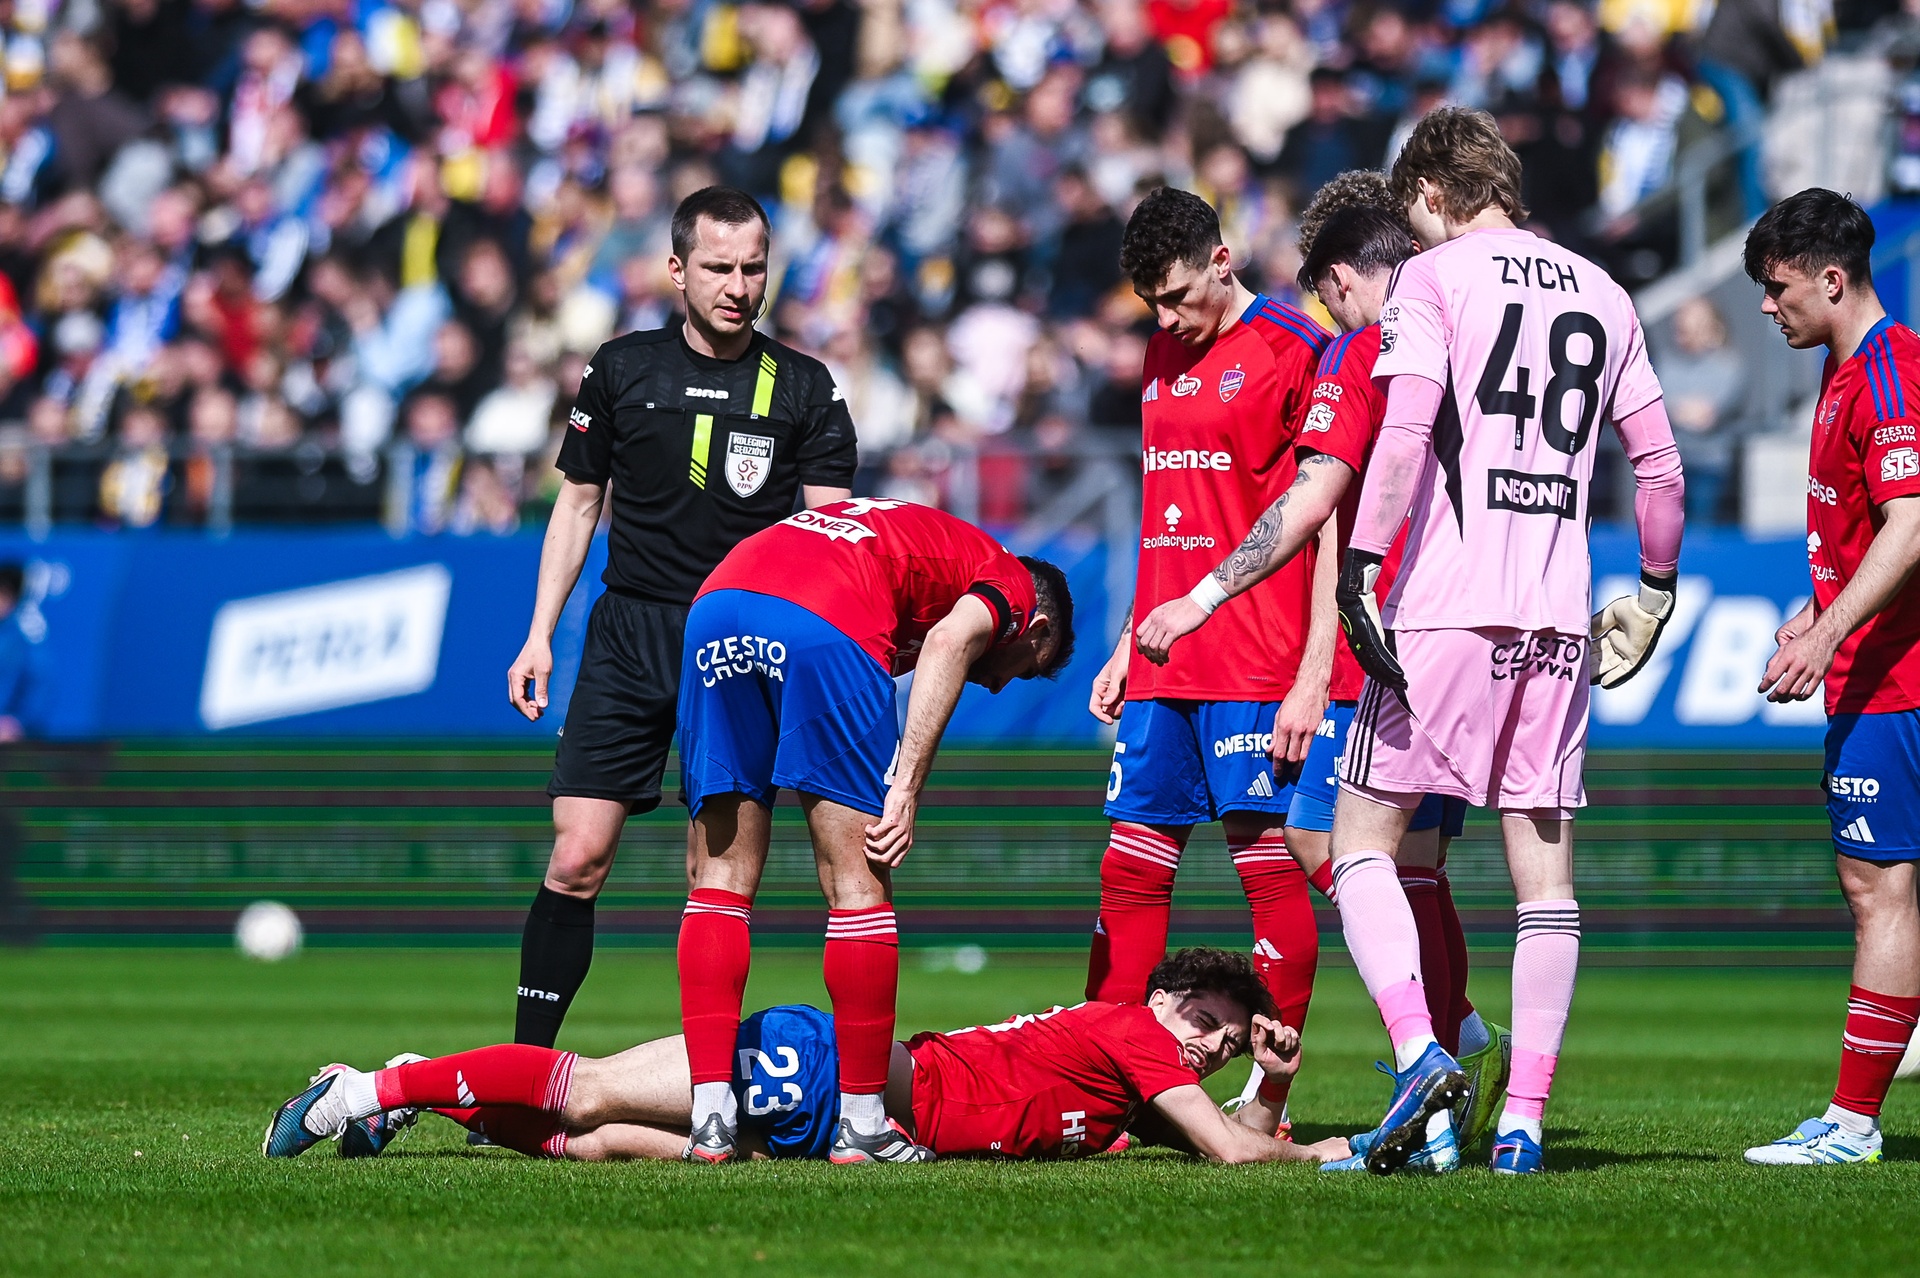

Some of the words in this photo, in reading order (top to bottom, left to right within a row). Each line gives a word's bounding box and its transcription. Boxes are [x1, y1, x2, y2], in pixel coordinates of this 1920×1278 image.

[1492, 256, 1580, 294] ZYCH
[1475, 303, 1607, 457] 48
[570, 406, 593, 428] LACK
[732, 434, 770, 449] KOLEGIUM
[1881, 447, 1919, 482] STS
[737, 482, 752, 490] PZPN
[792, 513, 866, 534] ONET
[1143, 532, 1215, 551] zodacrypto
[696, 635, 786, 672] CZĘSTO
[1491, 636, 1581, 664] CZSTO
[1827, 774, 1880, 797] ESTO
[738, 1046, 803, 1116] 23
[1060, 1110, 1086, 1160] His
